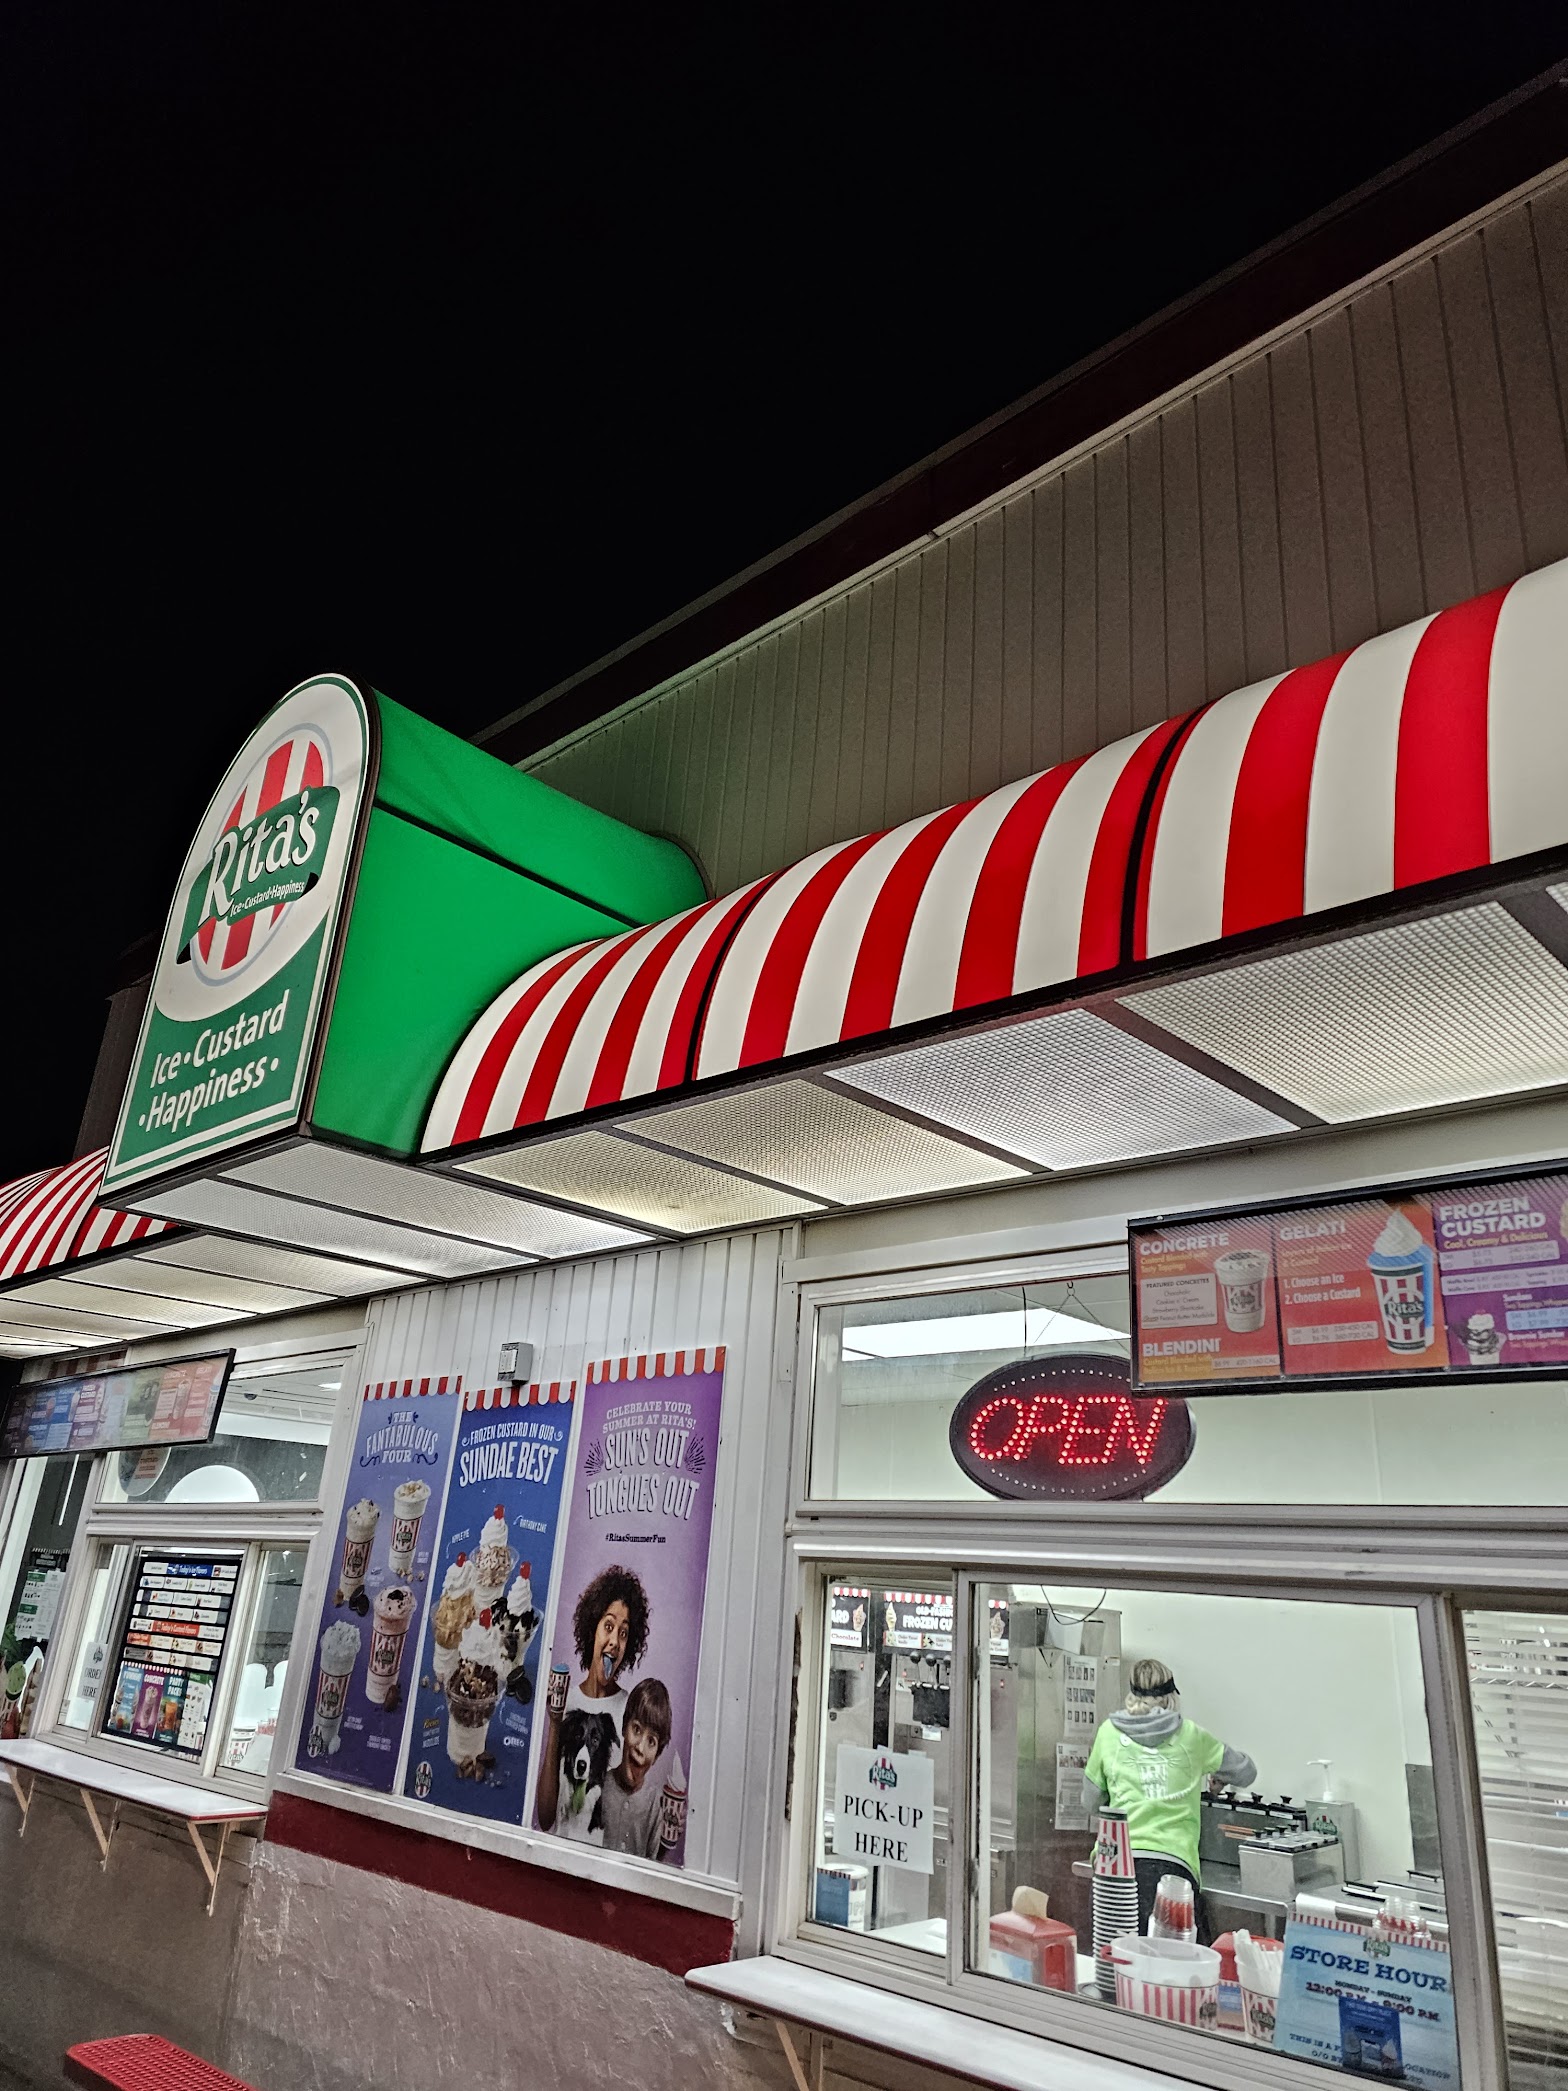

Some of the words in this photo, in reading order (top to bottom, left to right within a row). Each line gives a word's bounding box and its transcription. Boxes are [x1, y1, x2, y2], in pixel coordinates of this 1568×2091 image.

[198, 791, 319, 927] Rita's
[1440, 1196, 1530, 1221] FROZEN
[1280, 1220, 1346, 1241] GELATI
[1441, 1212, 1546, 1238] CUSTARD
[1139, 1232, 1230, 1255] CONCRETE
[1292, 1277, 1320, 1288] Choose
[1320, 1276, 1332, 1285] an
[1332, 1273, 1345, 1284] Ice
[1293, 1291, 1322, 1303] Choose
[1323, 1292, 1329, 1300] a
[1330, 1287, 1361, 1299] Custard
[1387, 1301, 1424, 1315] Rita's
[1142, 1337, 1221, 1357] BLENDINI
[393, 1411, 413, 1423] THE
[606, 1401, 662, 1420] CELEBRATE
[664, 1401, 692, 1415] YOUR
[470, 1424, 496, 1446] FROZEN
[496, 1422, 528, 1439] CUSTARD
[529, 1423, 539, 1438] IN
[539, 1423, 555, 1441] OUR
[602, 1414, 644, 1434] SUMMER
[646, 1414, 660, 1425] AT
[661, 1414, 697, 1430] RITA'S!
[969, 1396, 1170, 1465] OPEN
[366, 1424, 439, 1458] FANTABULOUS
[604, 1427, 650, 1471] SUN'S
[653, 1427, 690, 1469] OUT
[381, 1449, 412, 1463] FOUR
[459, 1441, 518, 1487] SUNDAE
[516, 1441, 559, 1485] BEST
[586, 1473, 660, 1520] TONGUES
[662, 1475, 700, 1520] OUT
[605, 1532, 667, 1544] #RitasSummerFun
[903, 1615, 938, 1630] FROZEN
[85, 1668, 102, 1680] ORDE
[503, 1735, 525, 1748] OREO
[873, 1765, 896, 1781] Rita's
[844, 1794, 923, 1828] PICK-UP
[855, 1832, 908, 1863] HERE
[1290, 1945, 1370, 1975] STORE
[1305, 1981, 1342, 1997] 12:00
[1335, 1980, 1370, 1994] MONDAY
[1377, 1989, 1412, 2003] SUNDAY
[1289, 2033, 1312, 2045] THIS
[1314, 2039, 1323, 2048] IS
[1326, 2042, 1332, 2050] A
[1403, 2062, 1451, 2080] OCATION
